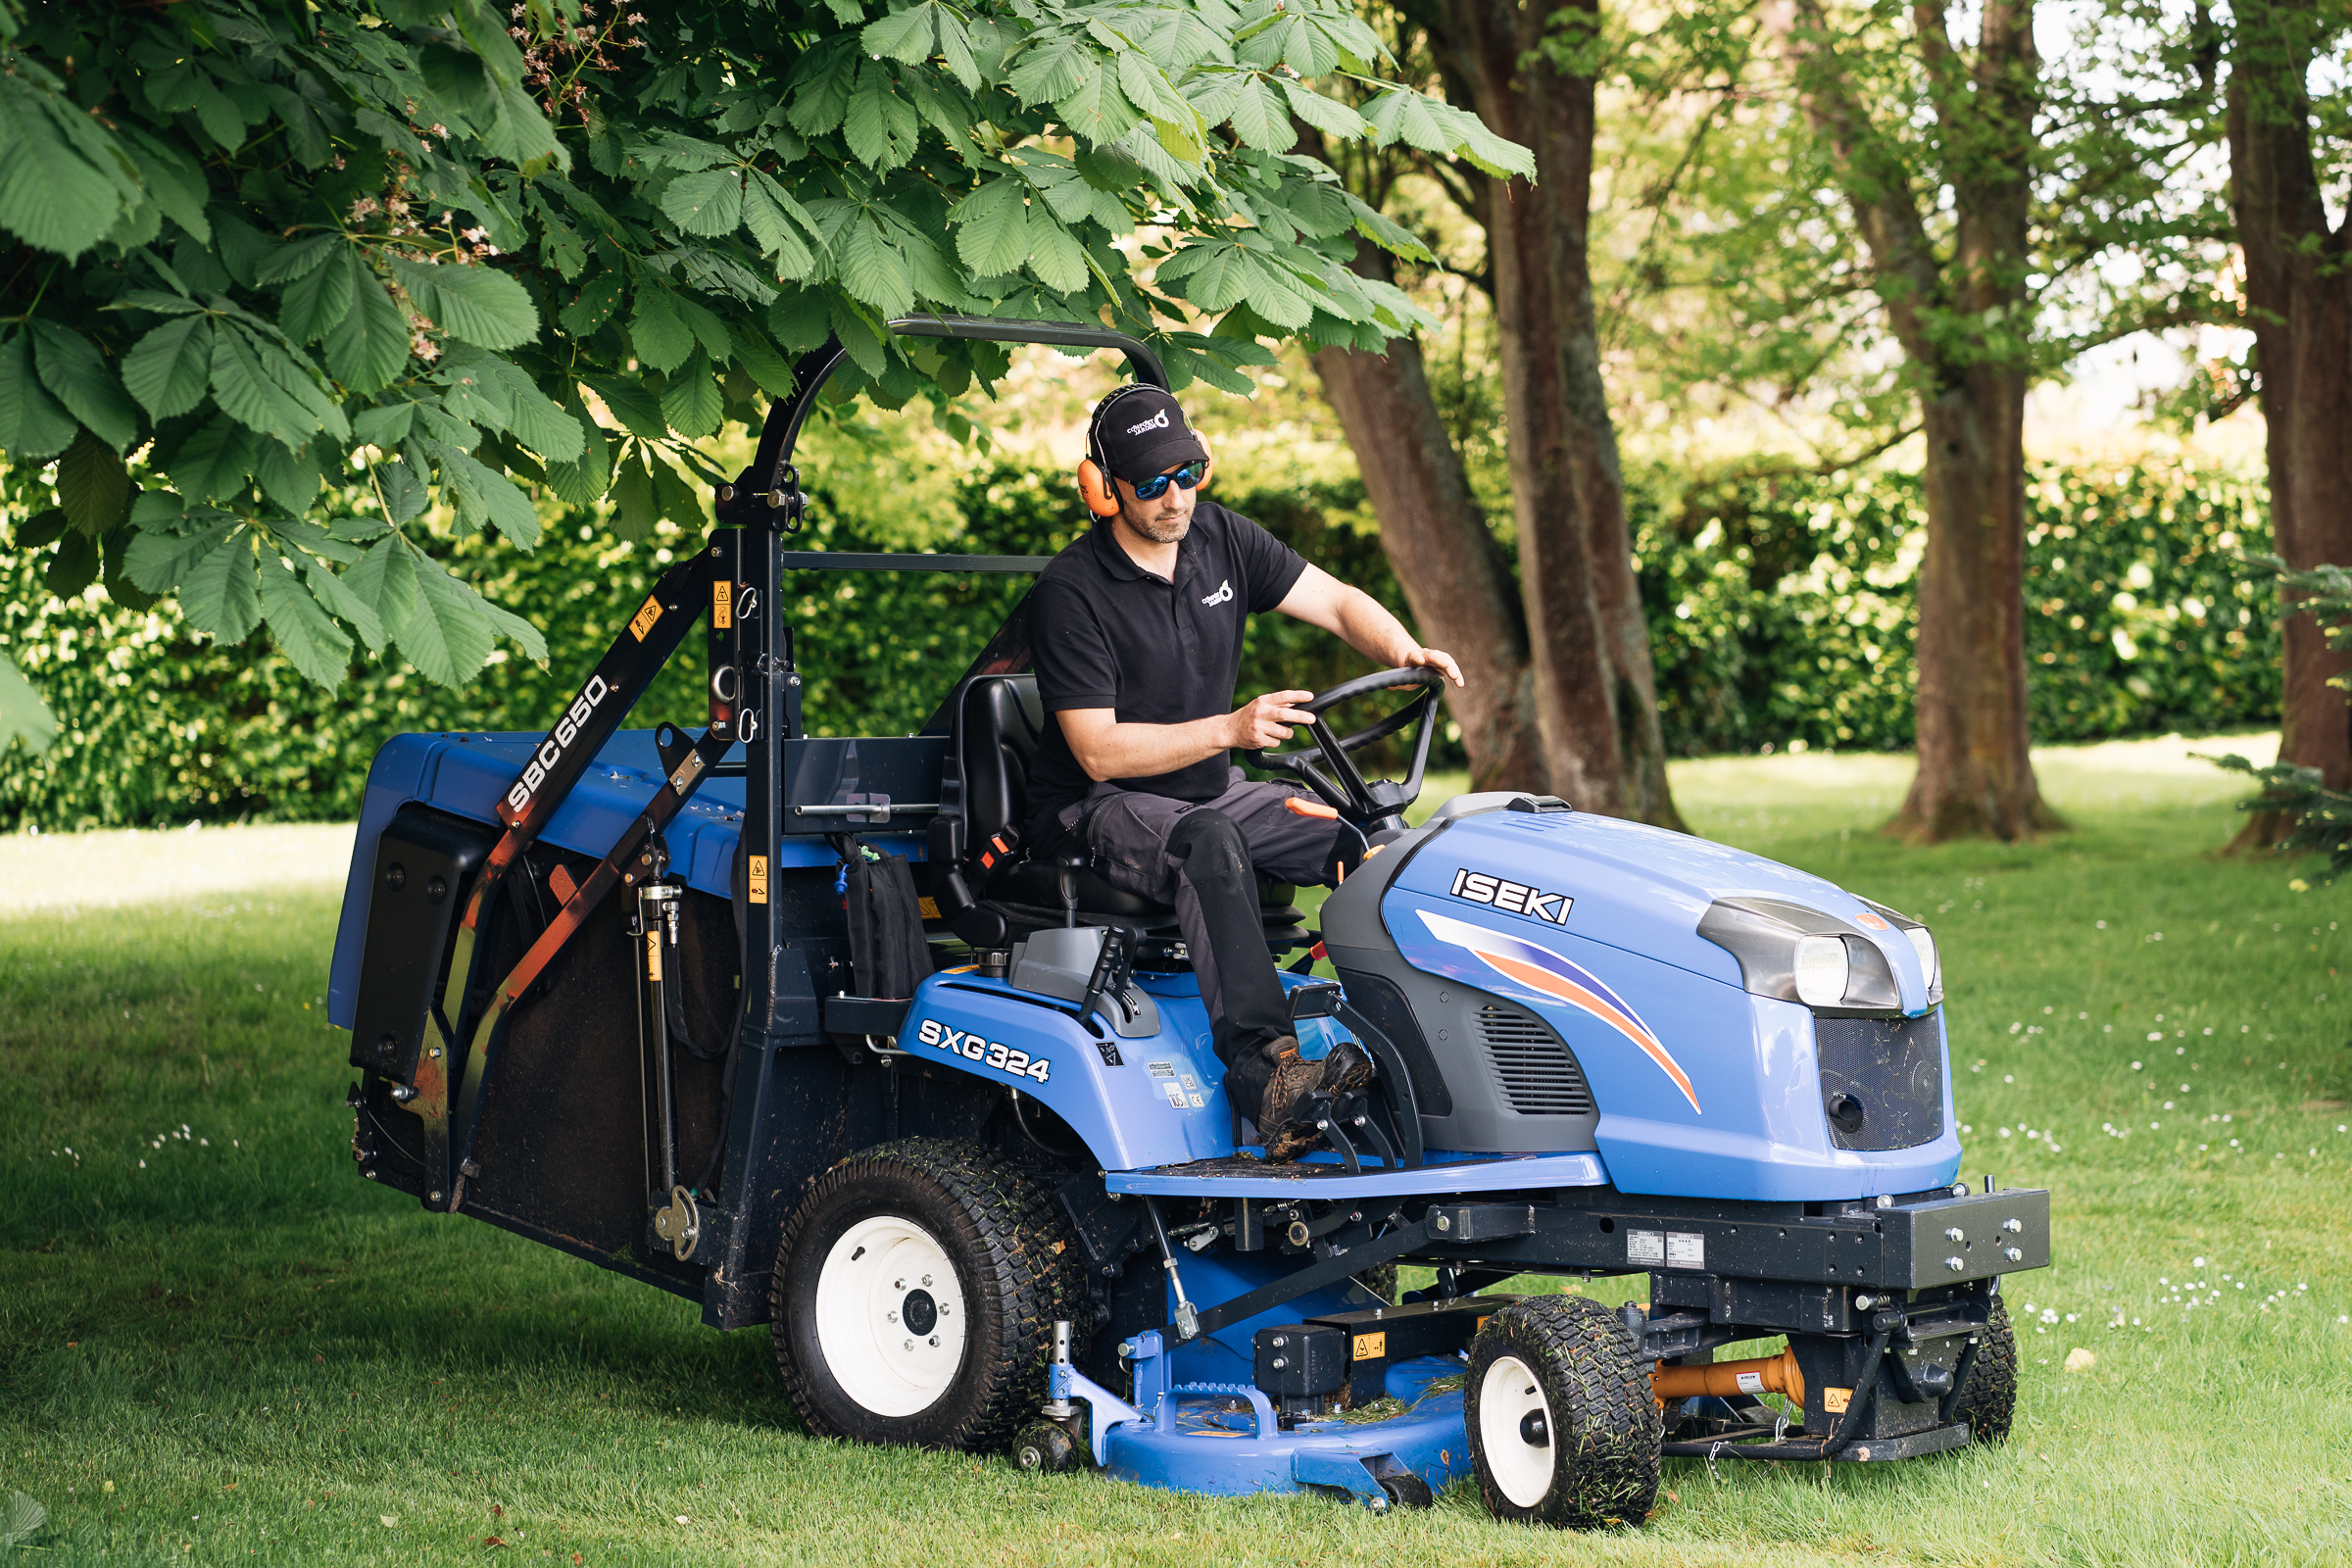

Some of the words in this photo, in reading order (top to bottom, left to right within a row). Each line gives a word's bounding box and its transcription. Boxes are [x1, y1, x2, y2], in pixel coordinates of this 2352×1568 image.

[508, 674, 608, 813] SBC650
[1449, 867, 1574, 926] ISEKI
[918, 1018, 1051, 1084] SXG324
